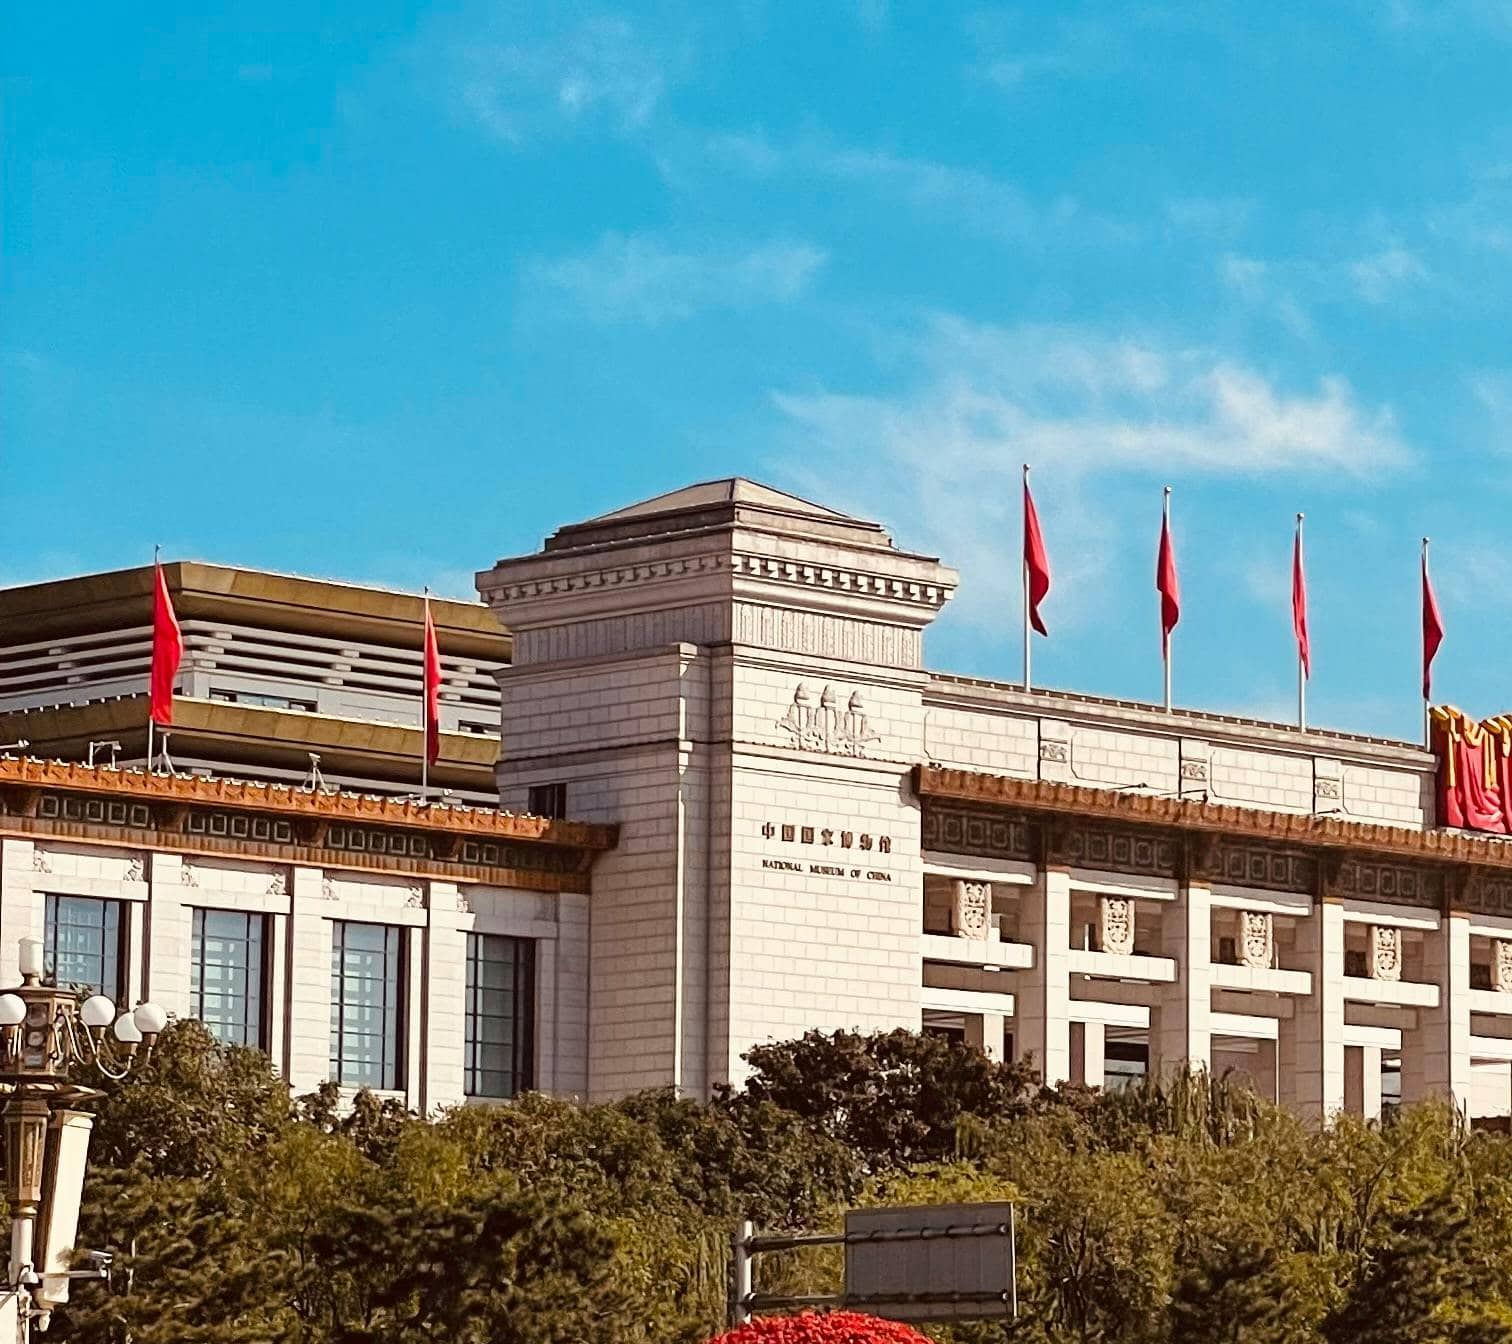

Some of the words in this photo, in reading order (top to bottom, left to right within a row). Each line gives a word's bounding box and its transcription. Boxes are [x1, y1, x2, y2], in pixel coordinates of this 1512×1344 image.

[762, 859, 803, 872] NATIONAL
[810, 865, 844, 876] MUSEUM
[850, 869, 861, 878] OF
[866, 871, 891, 881] CHINA
